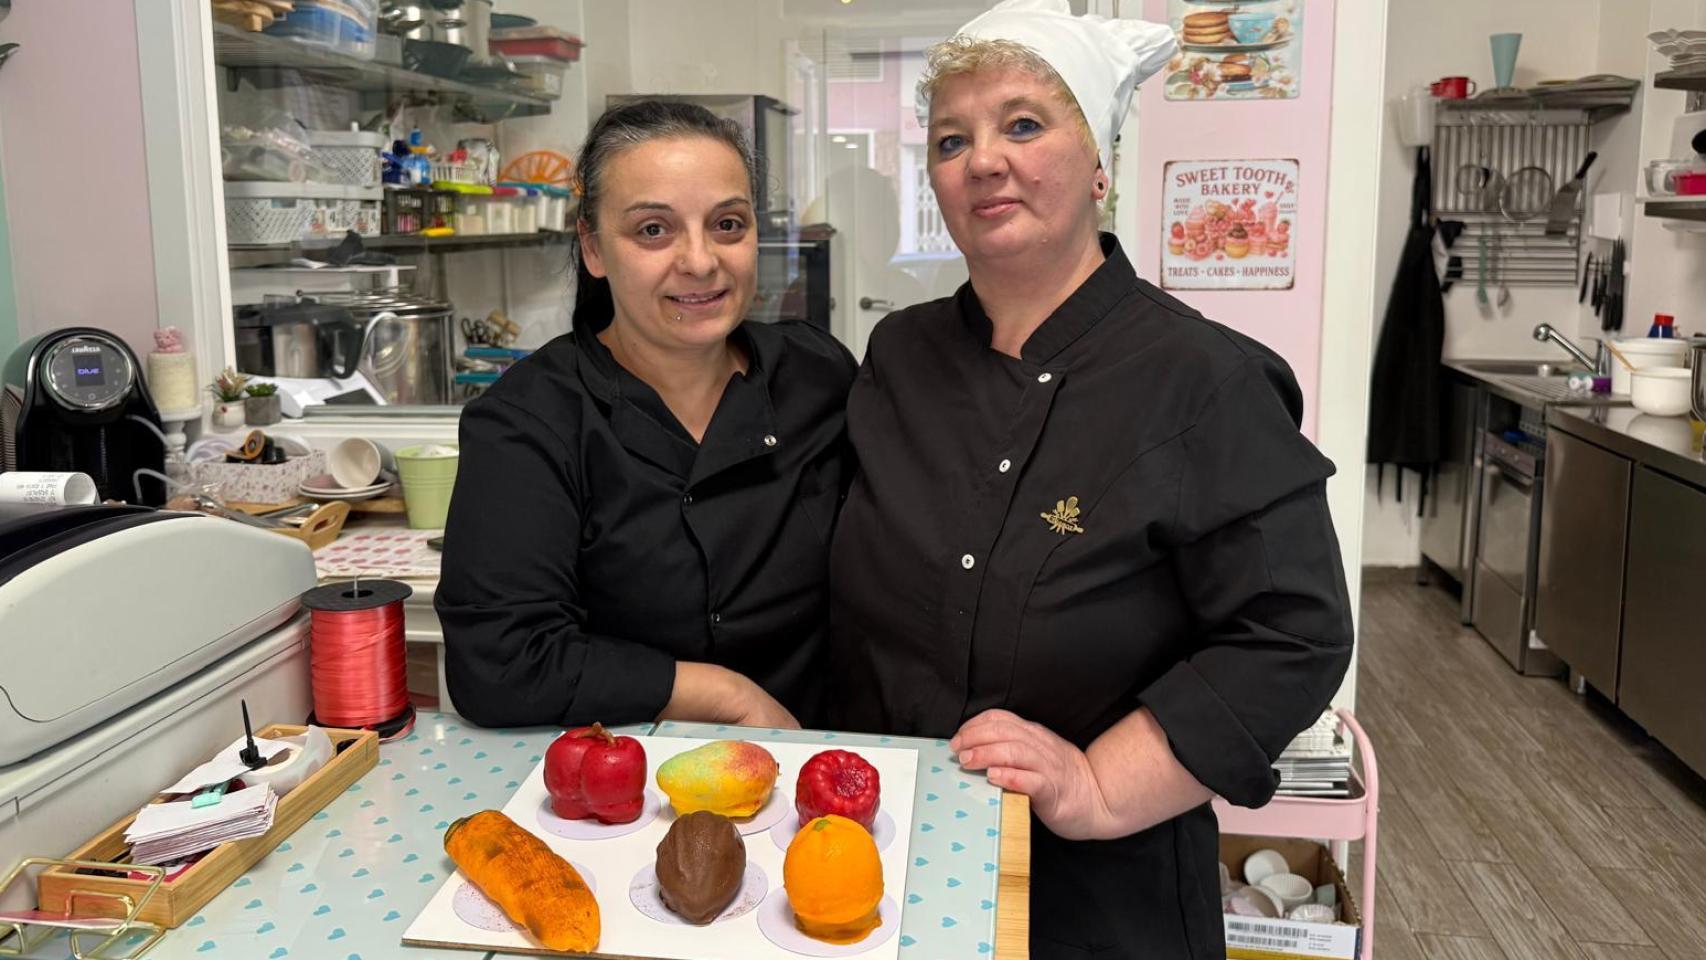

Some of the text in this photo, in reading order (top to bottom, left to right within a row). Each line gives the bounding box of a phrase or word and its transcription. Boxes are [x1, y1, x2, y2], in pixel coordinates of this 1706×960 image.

[1175, 167, 1287, 187] SWEET TOOTH
[1201, 183, 1261, 196] BAKERY
[1167, 266, 1290, 277] TREATS CAKES HAPPINESS
